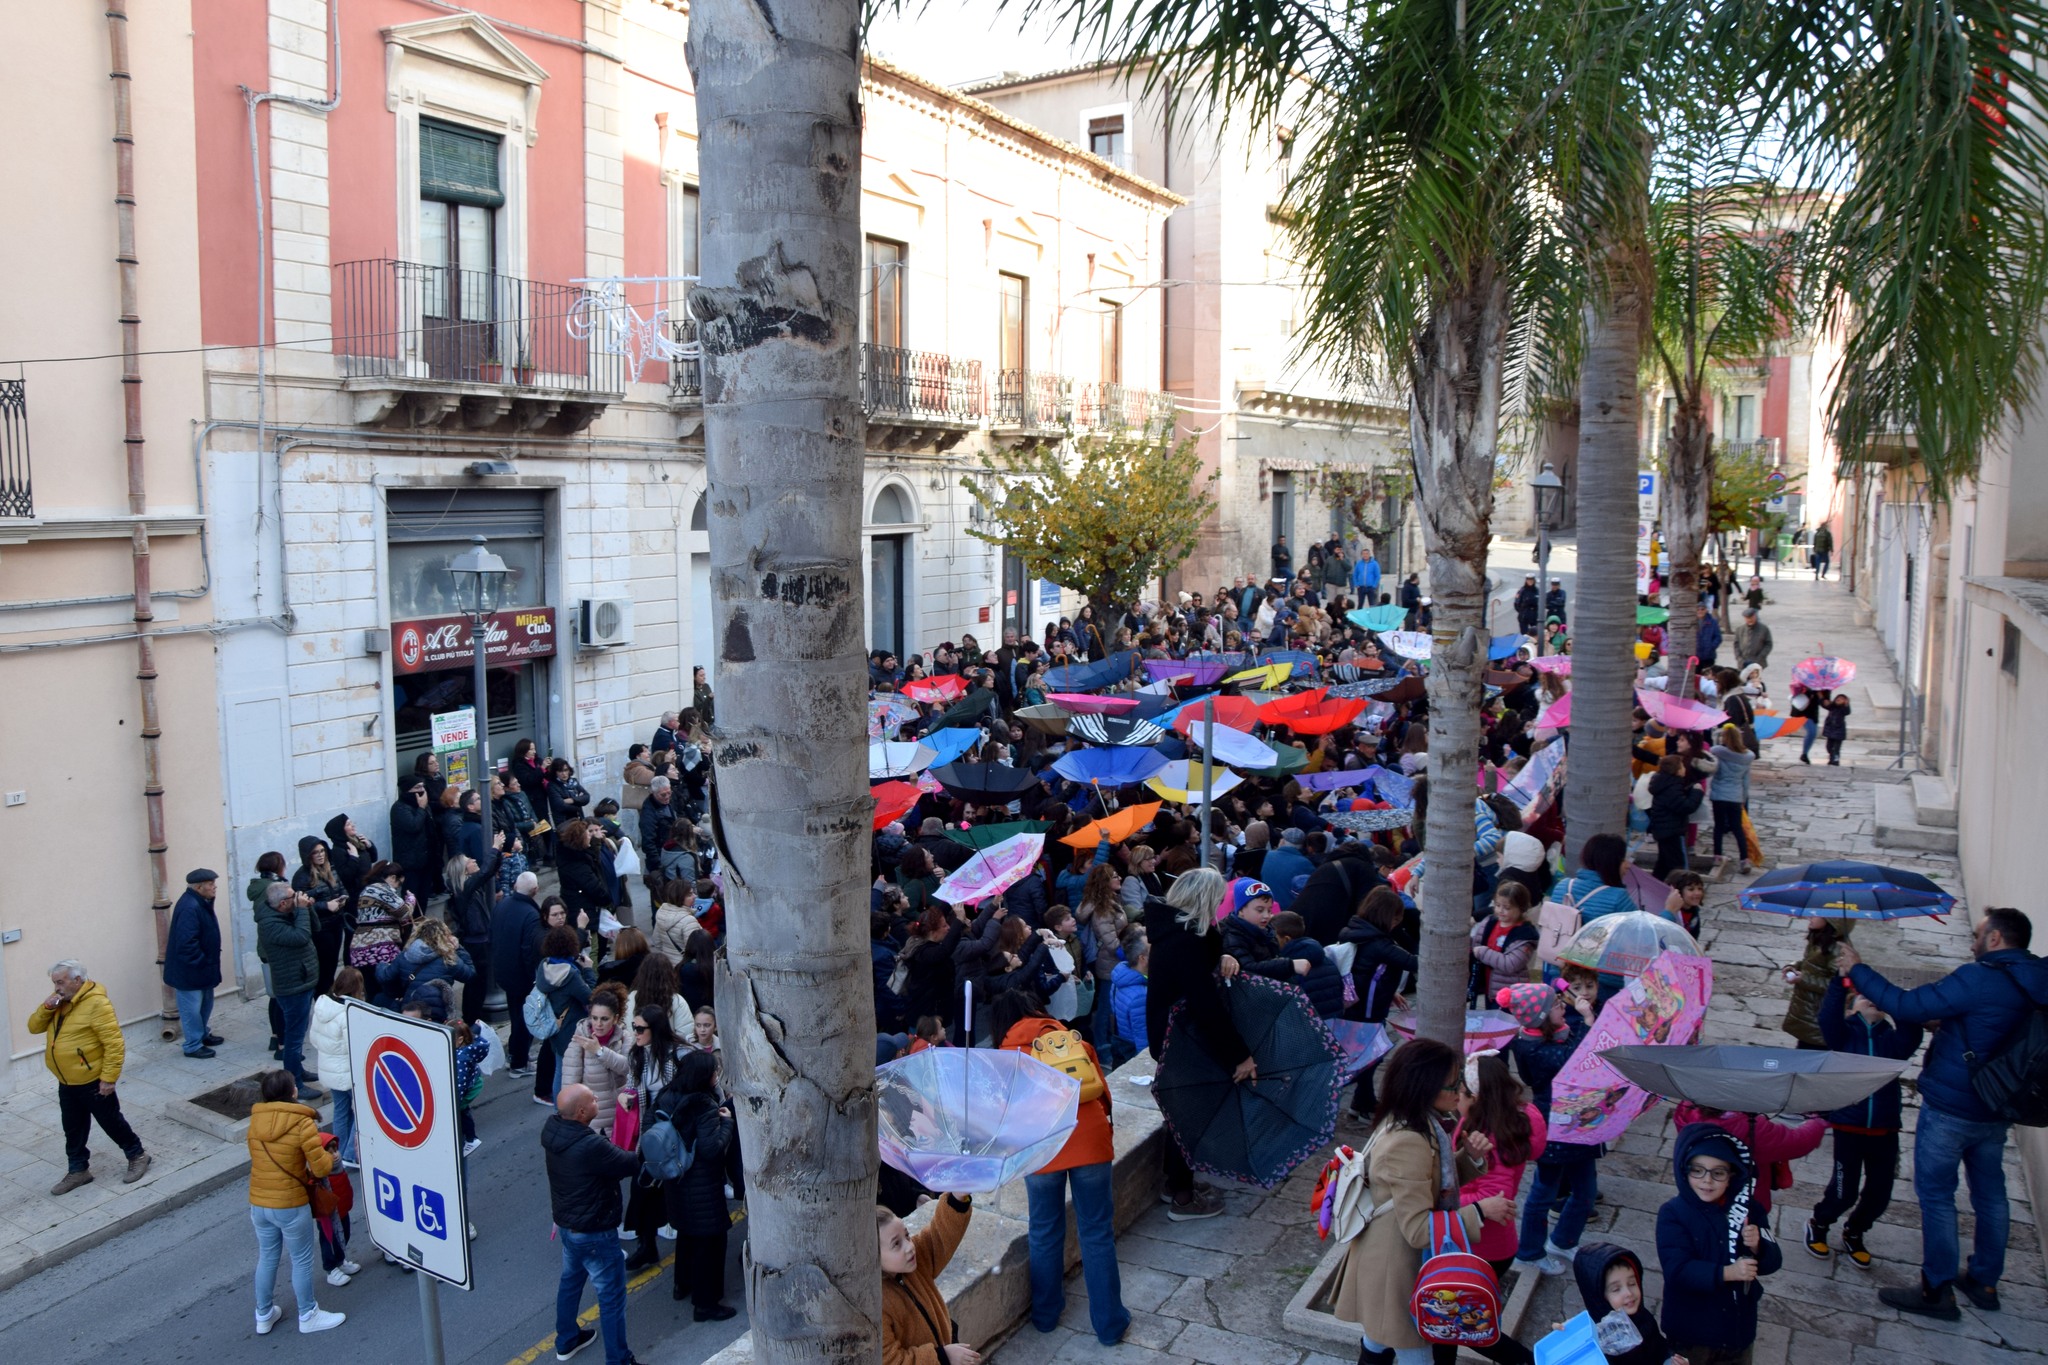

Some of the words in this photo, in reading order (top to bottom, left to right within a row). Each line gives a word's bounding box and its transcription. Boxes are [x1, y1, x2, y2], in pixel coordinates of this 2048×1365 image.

[1639, 478, 1650, 491] P
[516, 614, 546, 627] Milan
[527, 622, 552, 635] Club
[430, 653, 446, 661] CLUB
[488, 645, 508, 653] MONDO
[440, 730, 469, 743] VENDE
[13, 794, 21, 803] 17
[378, 1175, 396, 1211] P
